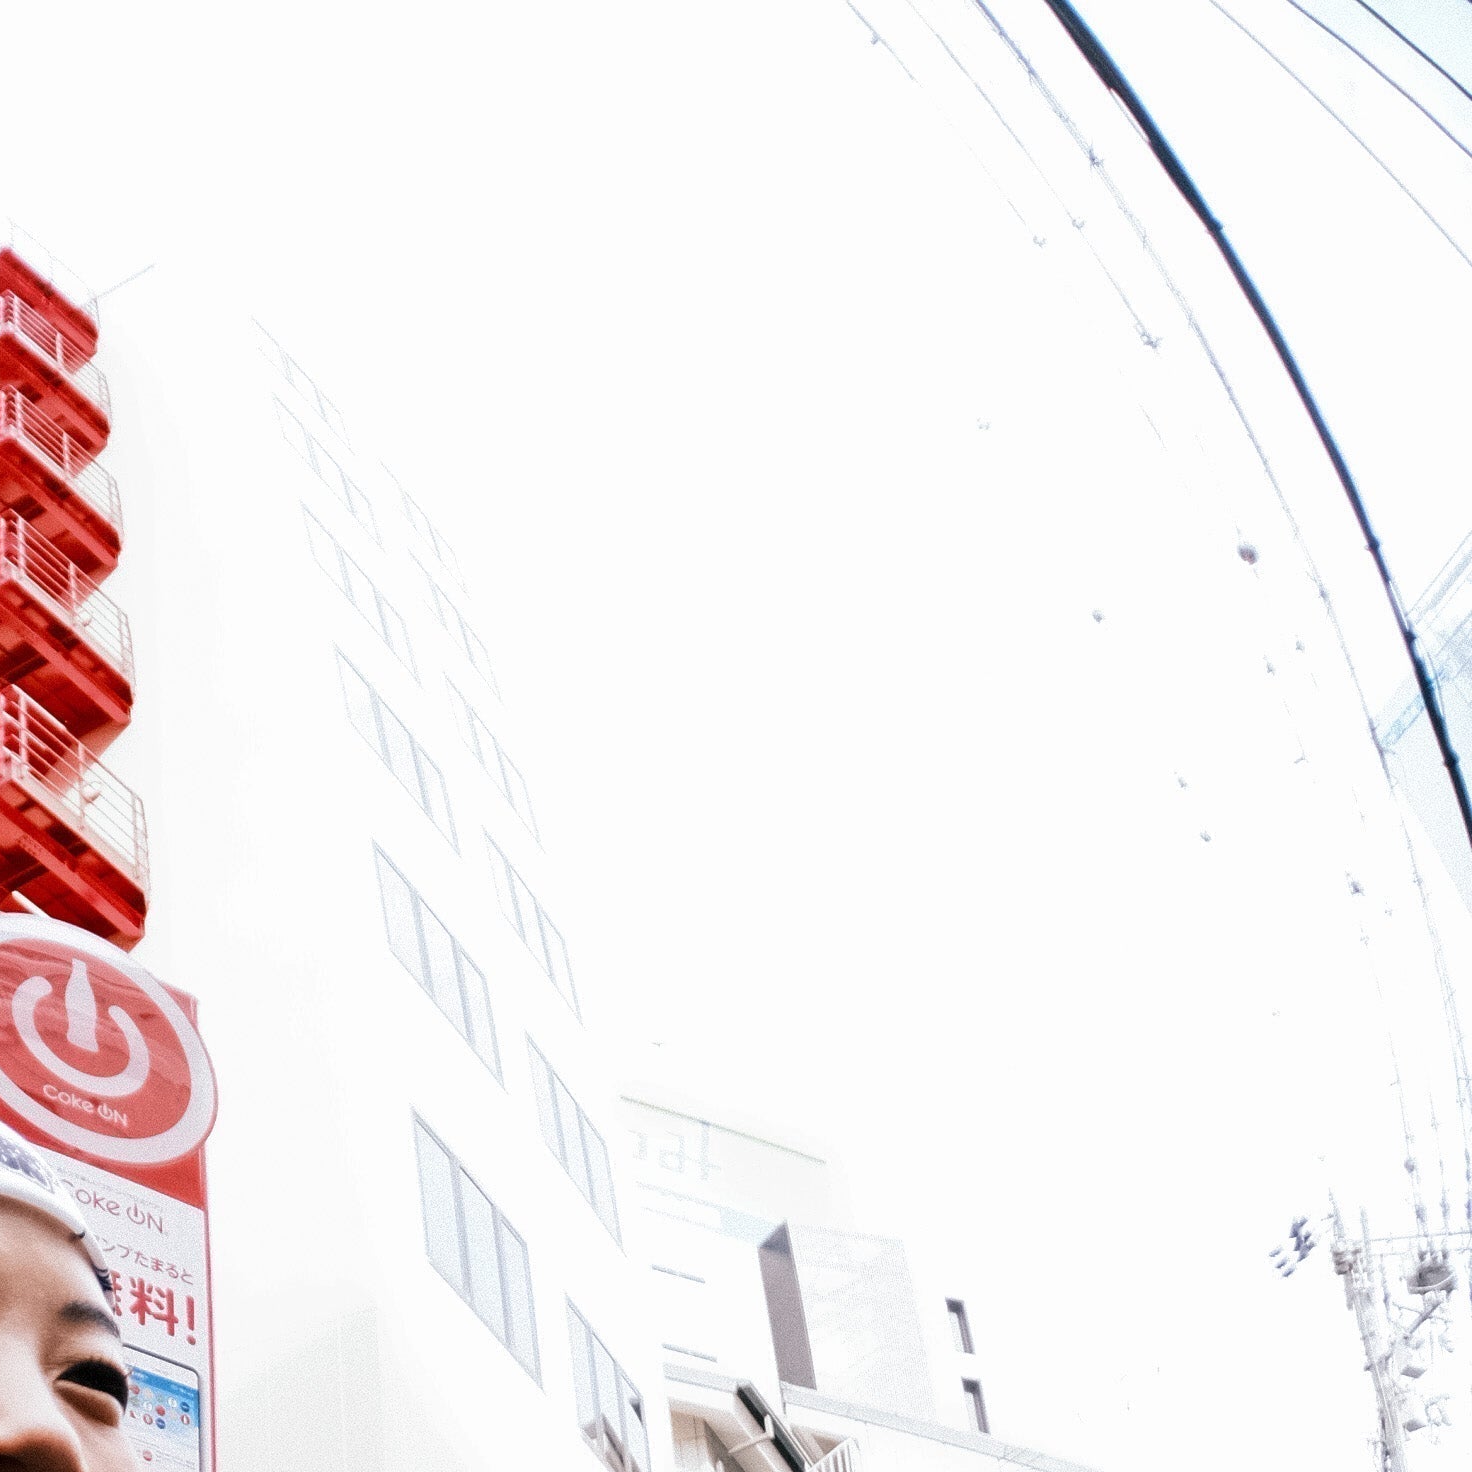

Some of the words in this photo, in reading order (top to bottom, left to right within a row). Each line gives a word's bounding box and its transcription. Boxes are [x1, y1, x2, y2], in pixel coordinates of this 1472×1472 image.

[42, 1083, 94, 1114] Coke
[93, 1233, 195, 1287] ンプたまると
